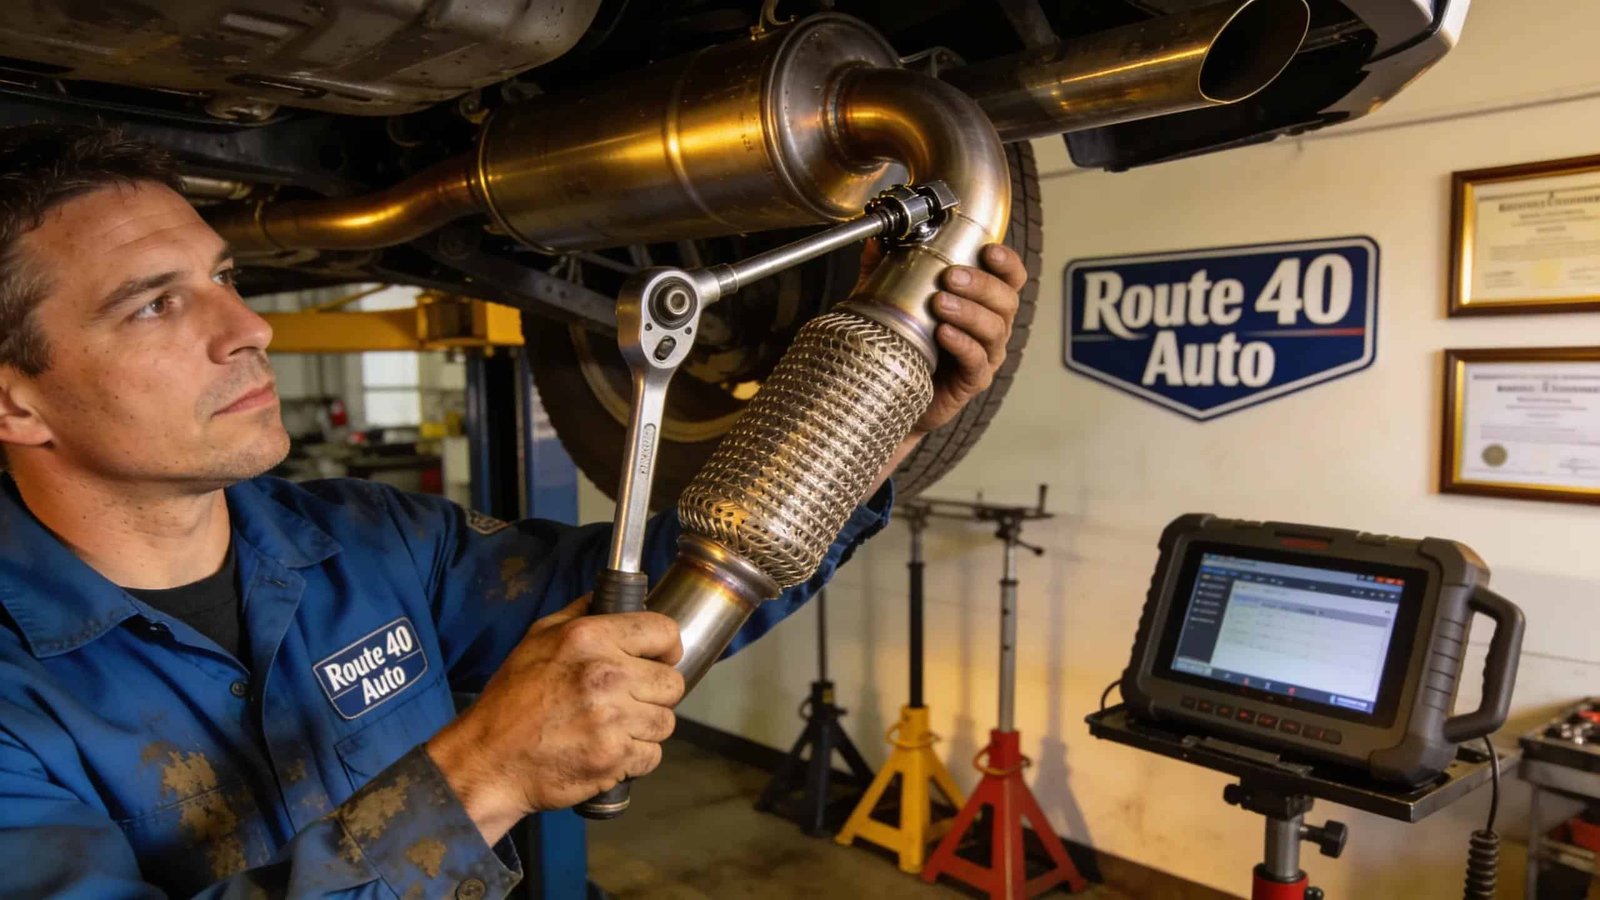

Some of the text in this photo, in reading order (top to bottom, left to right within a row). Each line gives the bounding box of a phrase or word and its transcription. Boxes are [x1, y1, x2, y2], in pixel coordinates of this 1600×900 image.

[1082, 253, 1353, 340] Route 40
[1141, 330, 1276, 388] Auto
[323, 625, 413, 692] Route 40
[361, 666, 406, 706] Auto
